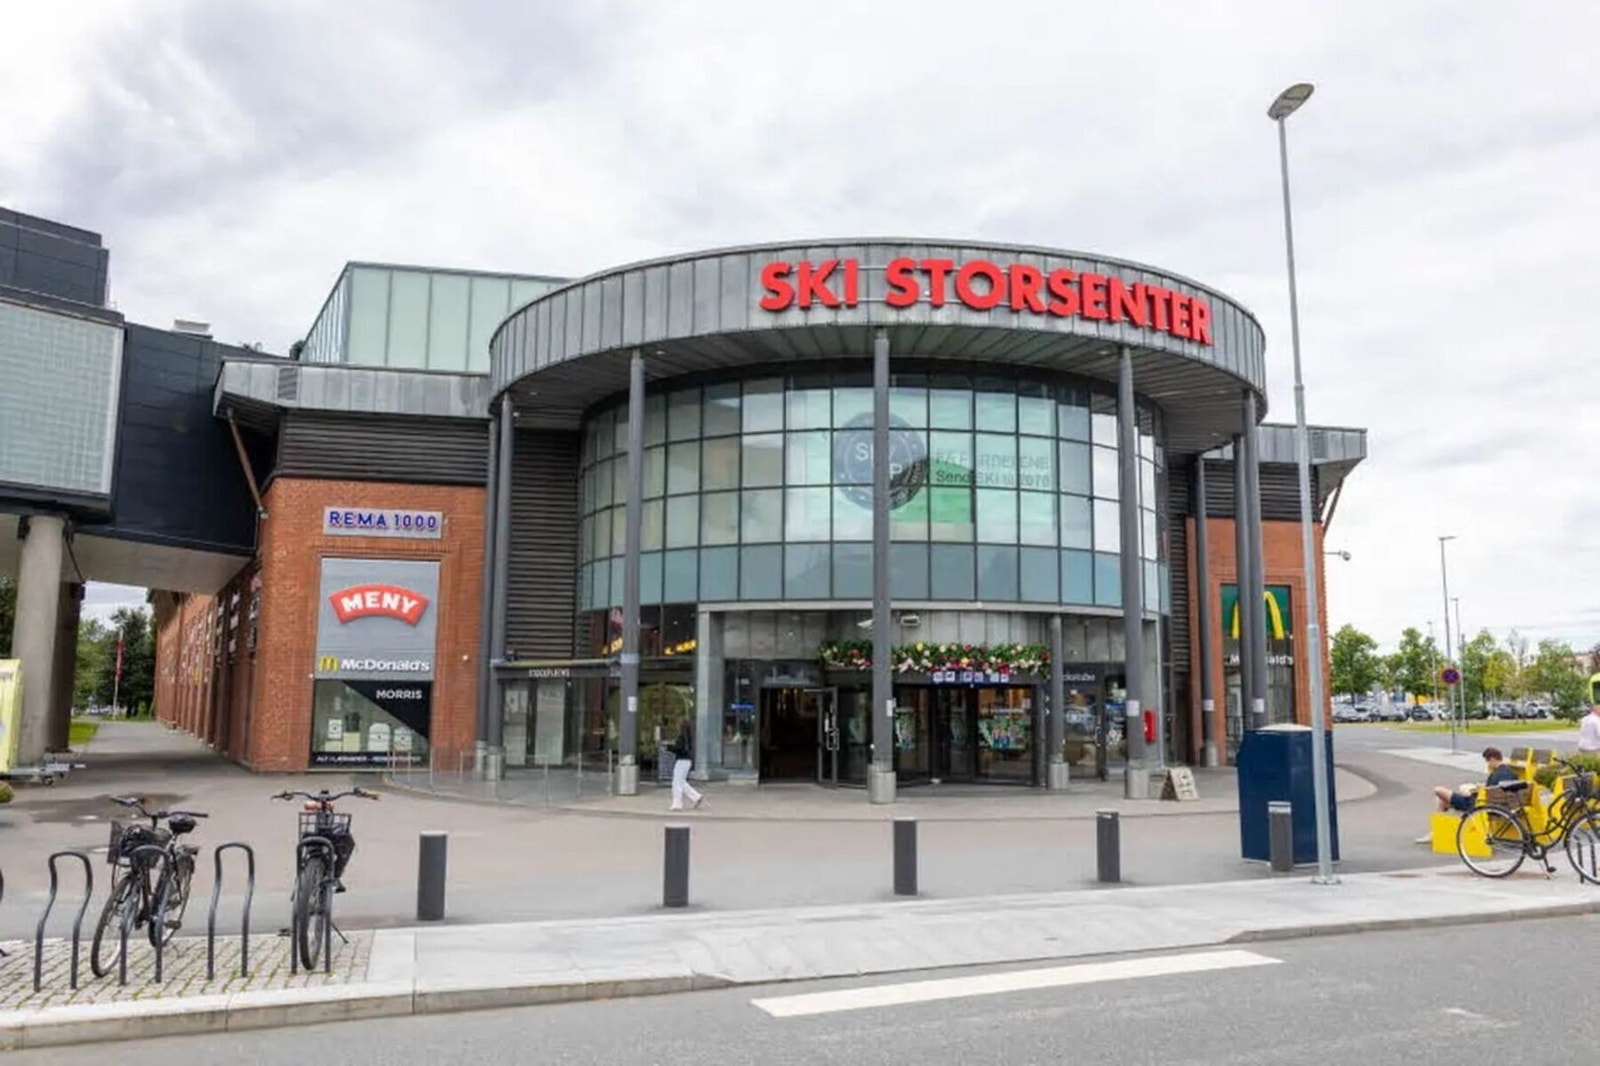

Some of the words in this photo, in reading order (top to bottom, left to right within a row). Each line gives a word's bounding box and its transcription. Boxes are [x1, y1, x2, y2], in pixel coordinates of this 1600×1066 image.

[759, 259, 858, 311] SKI
[885, 258, 1214, 346] STORSENTER
[329, 511, 387, 528] REMA
[394, 514, 437, 529] 1000
[340, 591, 419, 614] MENY
[341, 658, 430, 671] McDonald's
[376, 689, 422, 699] MORRIS
